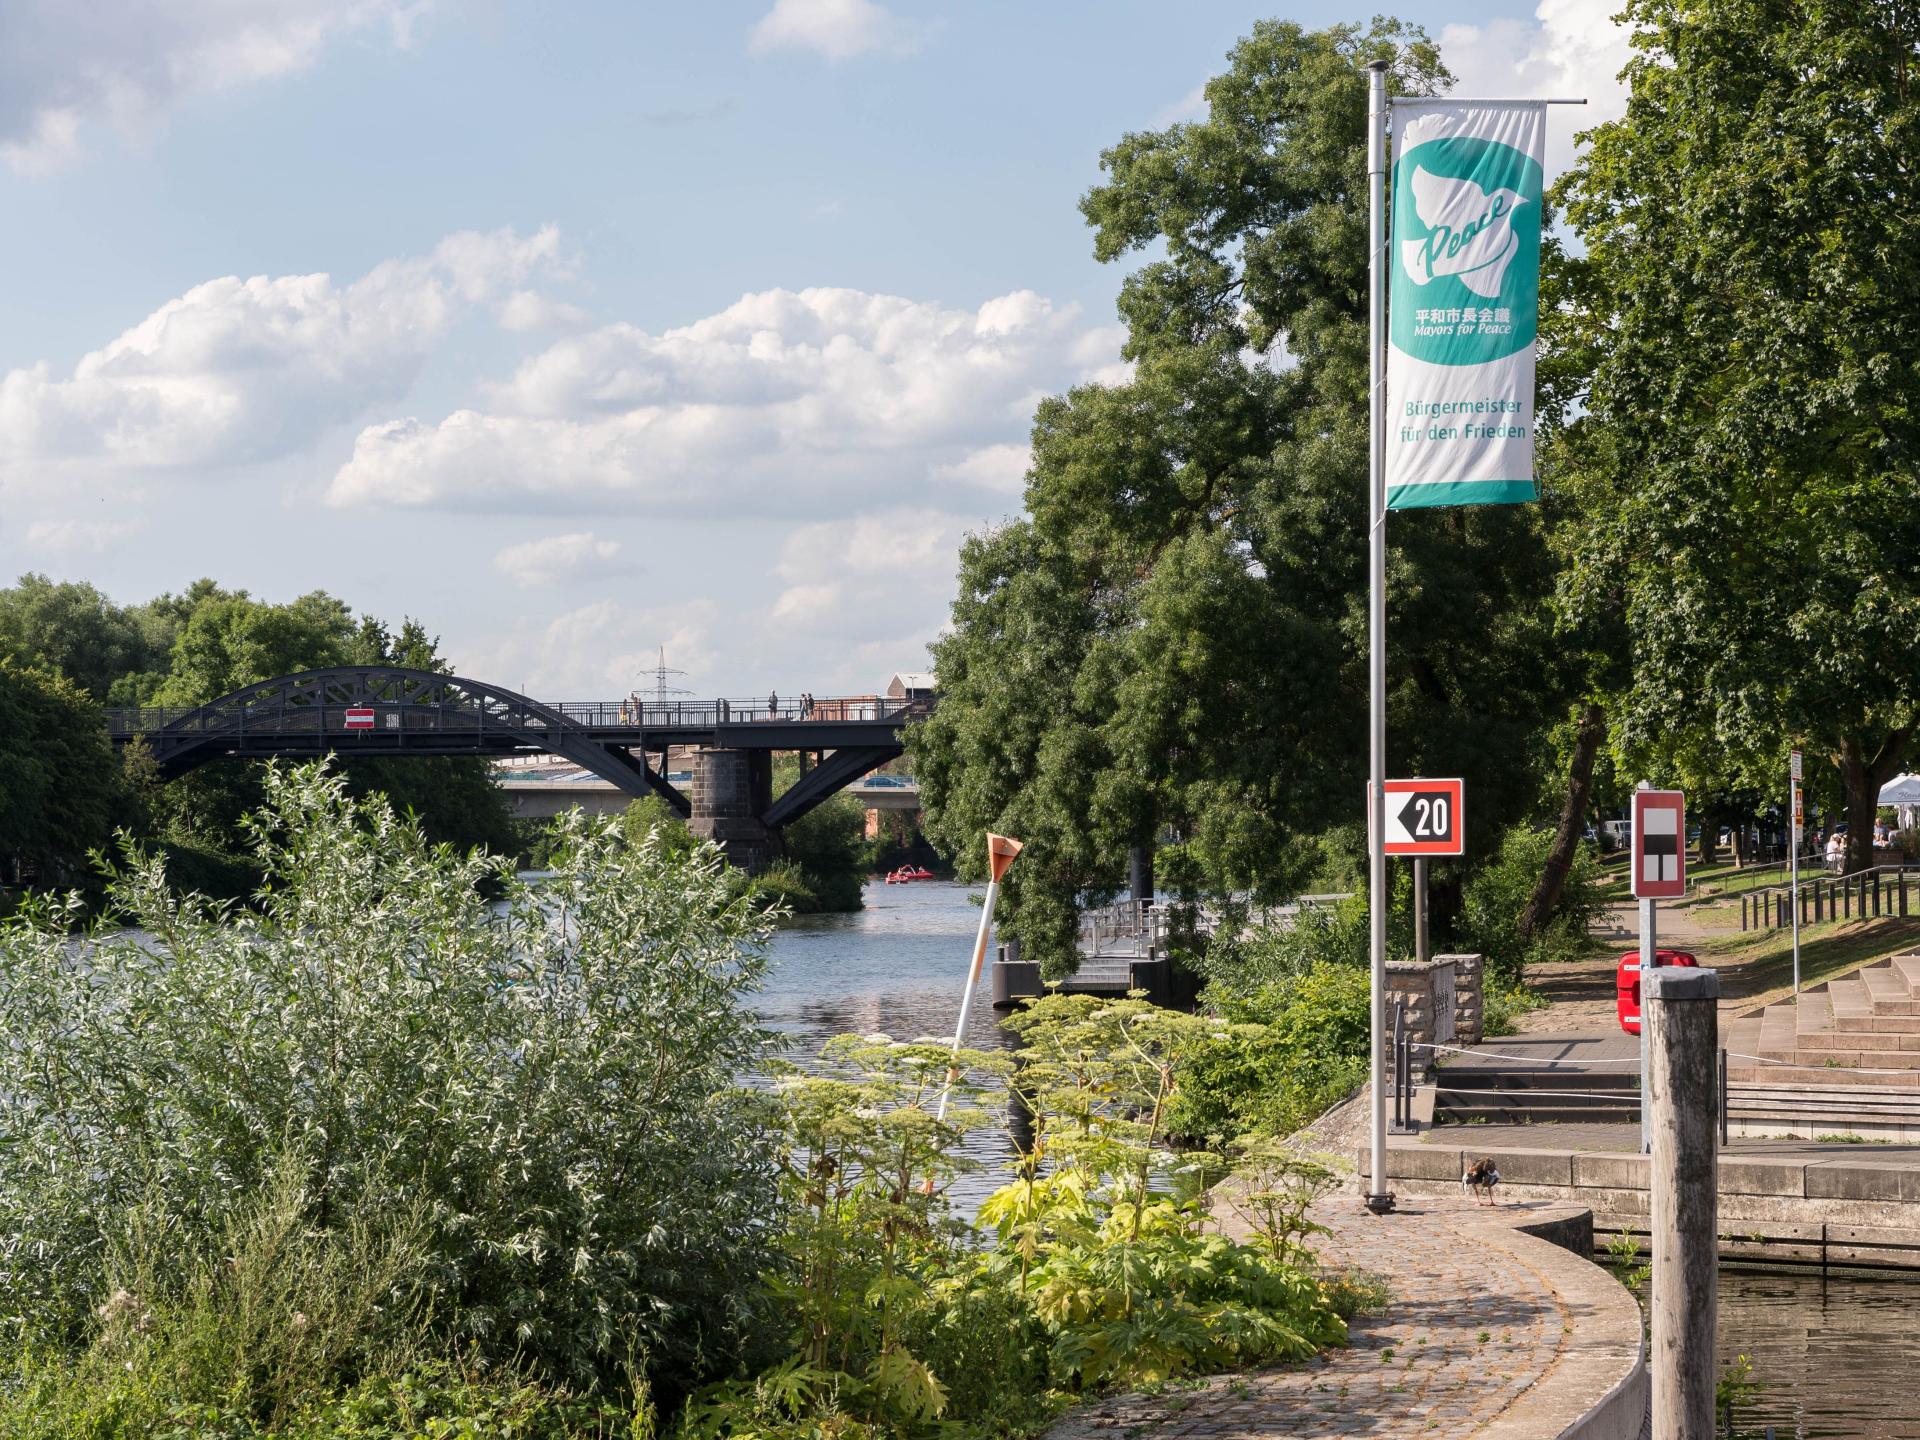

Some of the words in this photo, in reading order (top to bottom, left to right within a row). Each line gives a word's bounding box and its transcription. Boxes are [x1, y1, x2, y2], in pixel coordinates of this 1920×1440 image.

[1417, 195, 1512, 278] Peace
[1414, 325, 1454, 337] Mayors
[1456, 323, 1476, 336] for
[1477, 322, 1512, 335] Peace
[1405, 397, 1522, 419] Bürgermeister
[1400, 426, 1422, 442] für
[1428, 424, 1458, 440] den
[1465, 423, 1526, 439] Frieden
[1415, 798, 1447, 836] 20
